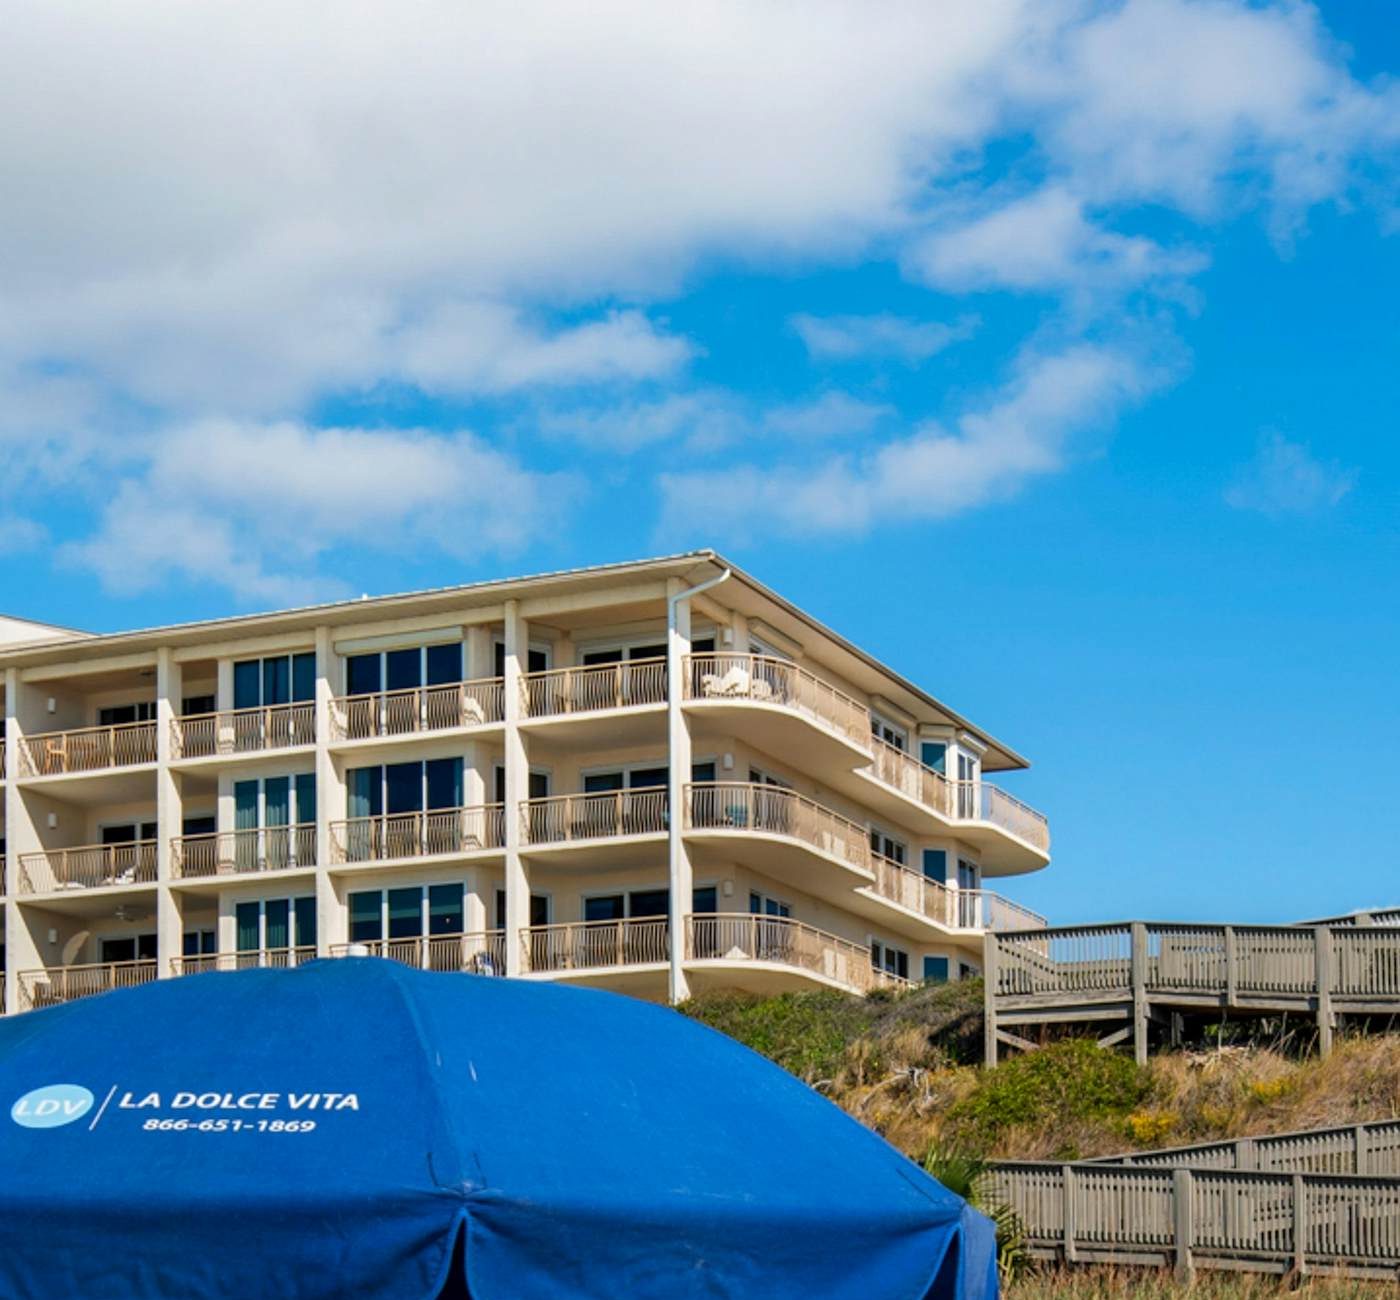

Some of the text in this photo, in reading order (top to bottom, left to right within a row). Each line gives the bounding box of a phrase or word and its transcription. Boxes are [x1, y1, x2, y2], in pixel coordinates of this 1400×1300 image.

[15, 1099, 87, 1117] LDV
[119, 1092, 359, 1110] LA DOLCE VITA
[143, 1119, 316, 1132] 866-651-1869
